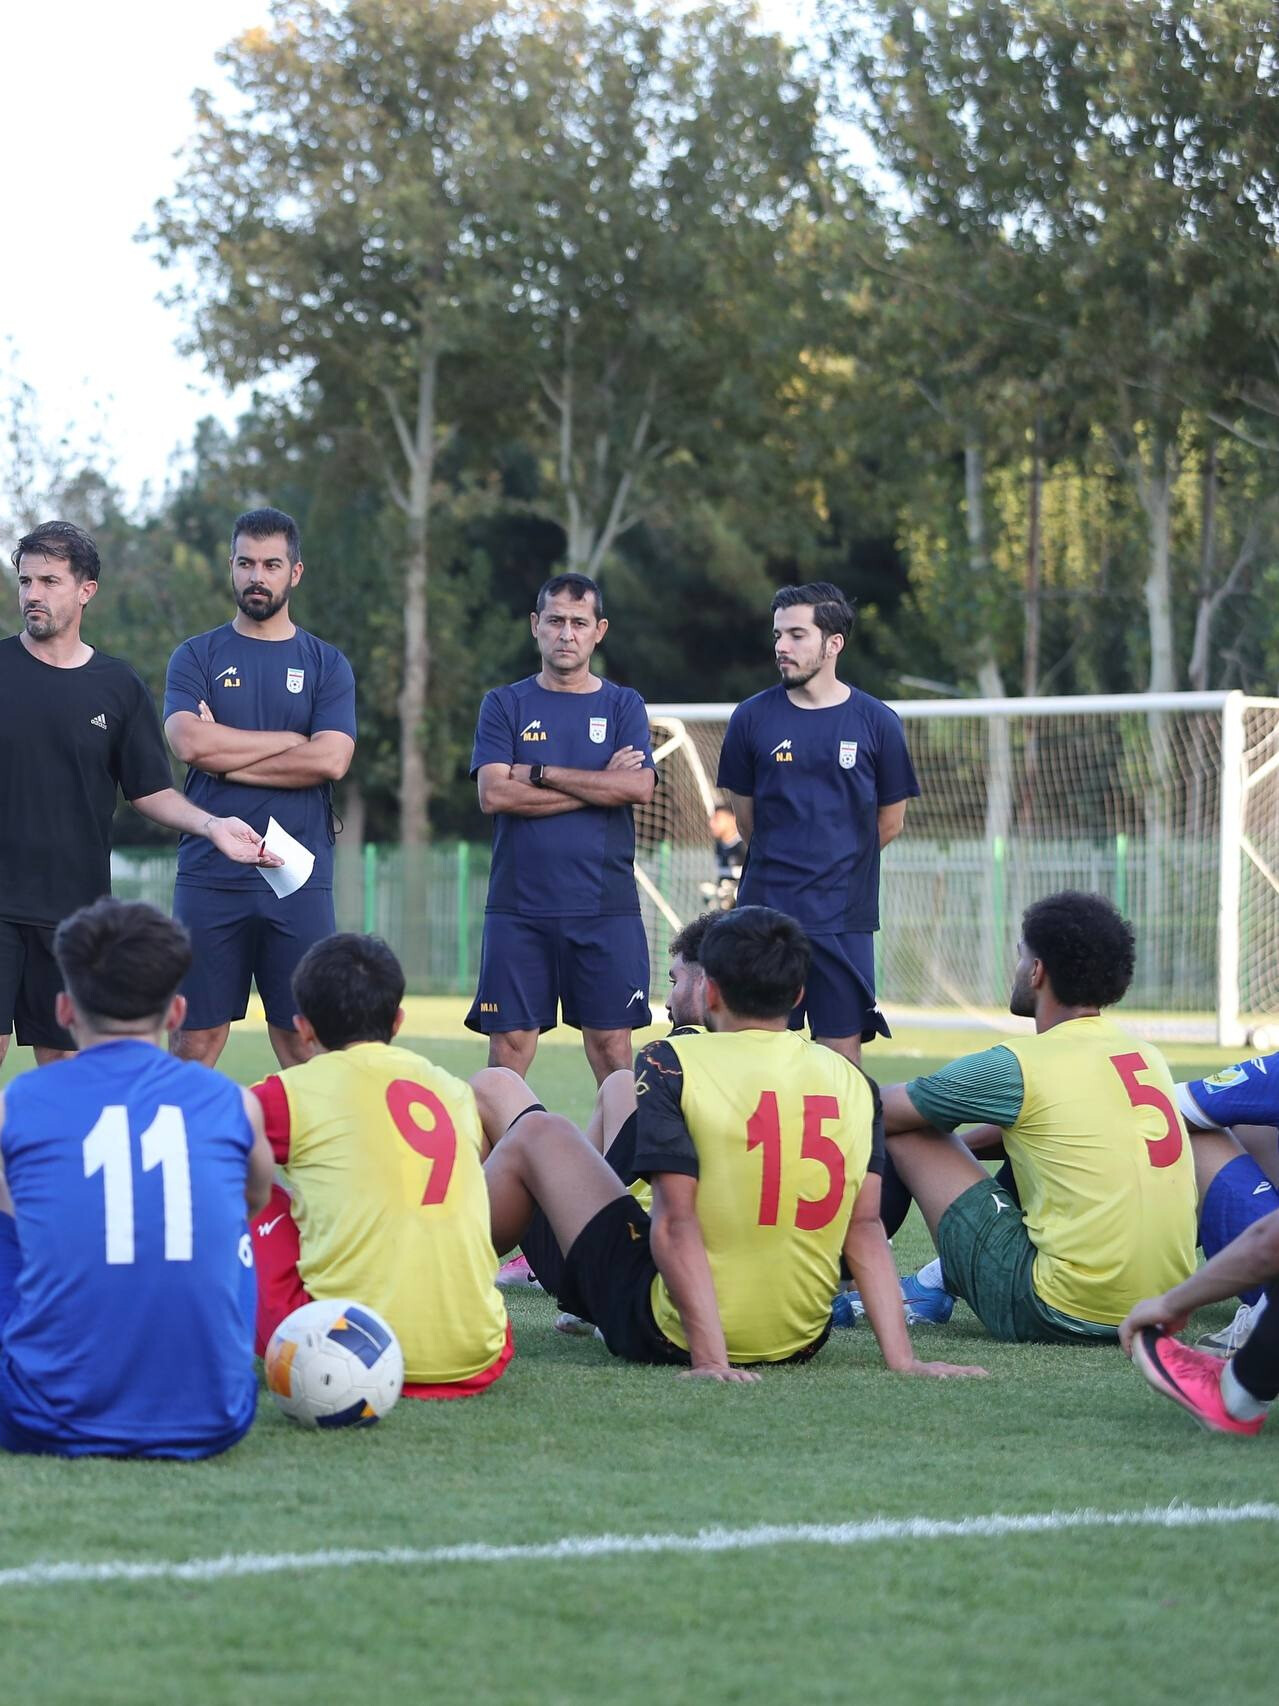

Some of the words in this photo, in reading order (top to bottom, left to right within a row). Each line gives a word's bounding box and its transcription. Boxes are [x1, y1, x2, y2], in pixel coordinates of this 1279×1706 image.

[386, 1079, 457, 1206] 9
[746, 1091, 846, 1231] 15
[1110, 1052, 1183, 1168] 5
[83, 1104, 192, 1264] 11
